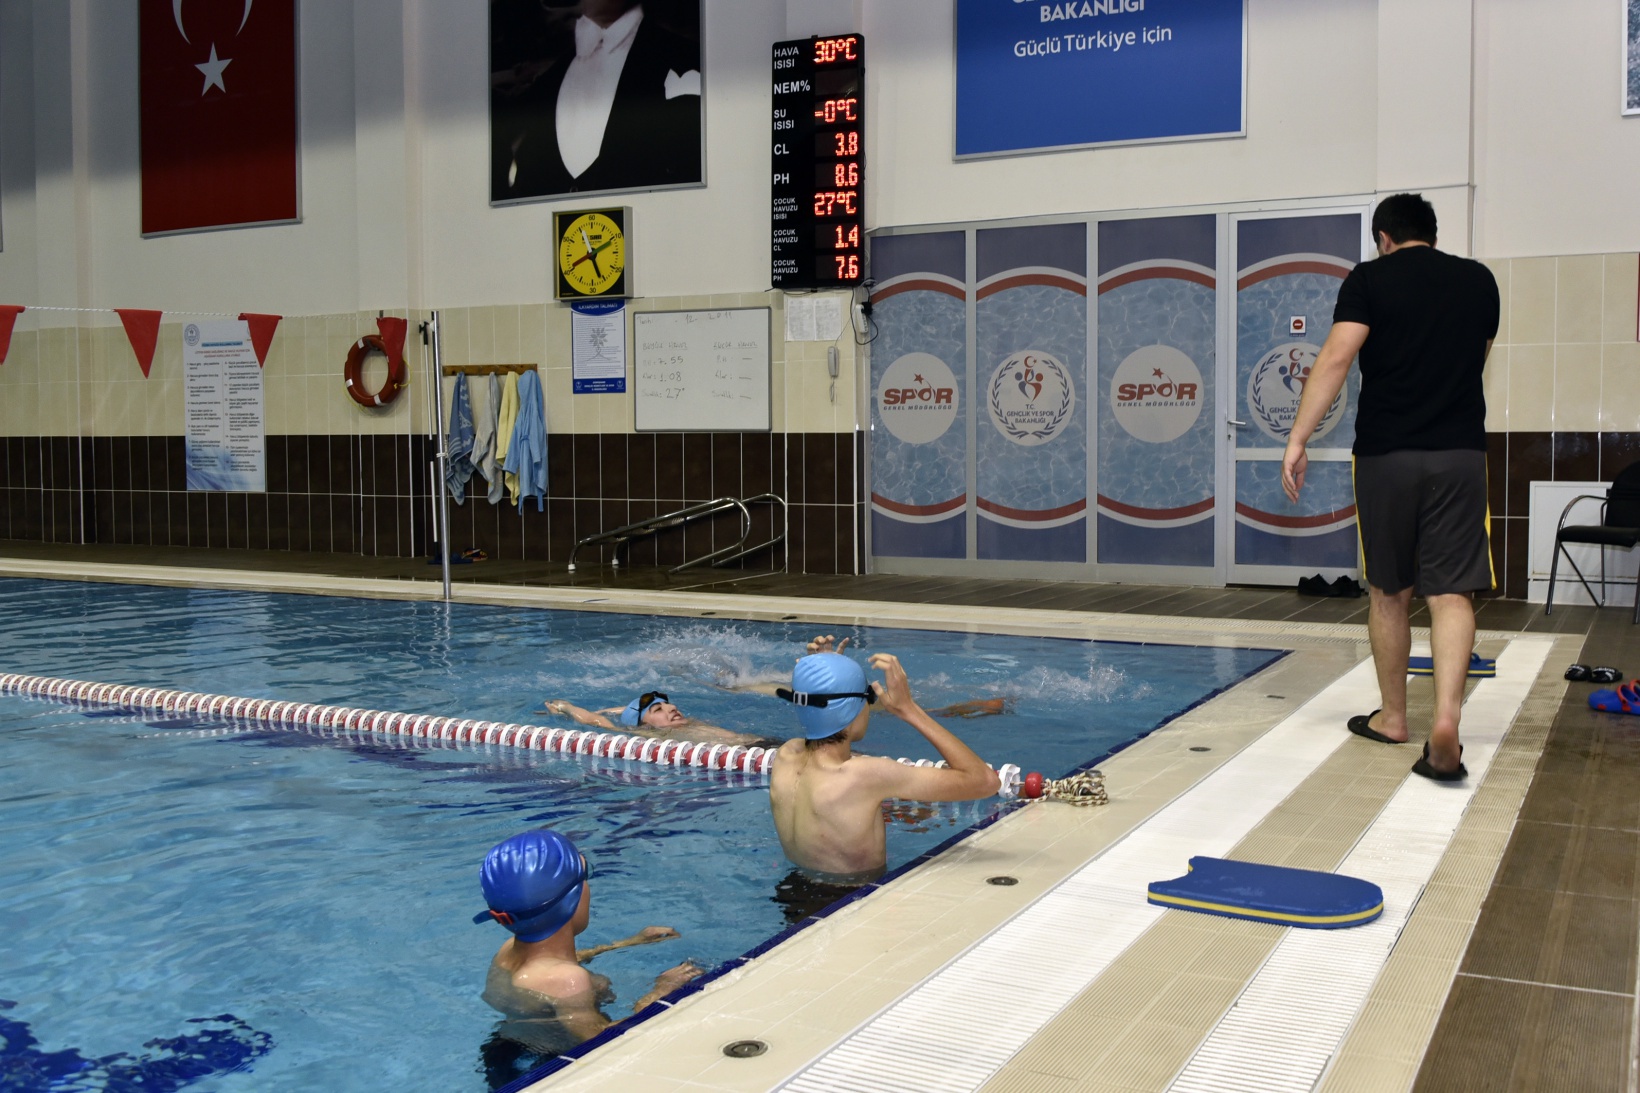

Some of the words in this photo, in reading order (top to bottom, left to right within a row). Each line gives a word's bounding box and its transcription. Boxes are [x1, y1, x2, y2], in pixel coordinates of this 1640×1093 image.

[1014, 37, 1061, 57] Güçlü
[1063, 30, 1136, 52] Türkiye
[1142, 26, 1172, 45] için
[774, 46, 799, 58] HAVA
[774, 59, 795, 70] ISISI
[774, 80, 811, 95] NEM%
[774, 109, 787, 119] SU
[773, 120, 795, 131] ISISI
[773, 144, 790, 155] CL
[835, 131, 858, 156] 3.8
[773, 173, 790, 185] PH
[835, 163, 858, 187] 8.6
[773, 197, 796, 206] ÇOCUK
[773, 205, 799, 213] HAVUZU
[773, 229, 796, 238] ÇOCUK
[835, 224, 858, 248] 1.4
[773, 259, 796, 268] ÇOCUK
[835, 255, 858, 279] 7.6
[883, 387, 953, 405] SPOR
[1117, 382, 1197, 401] SPOR
